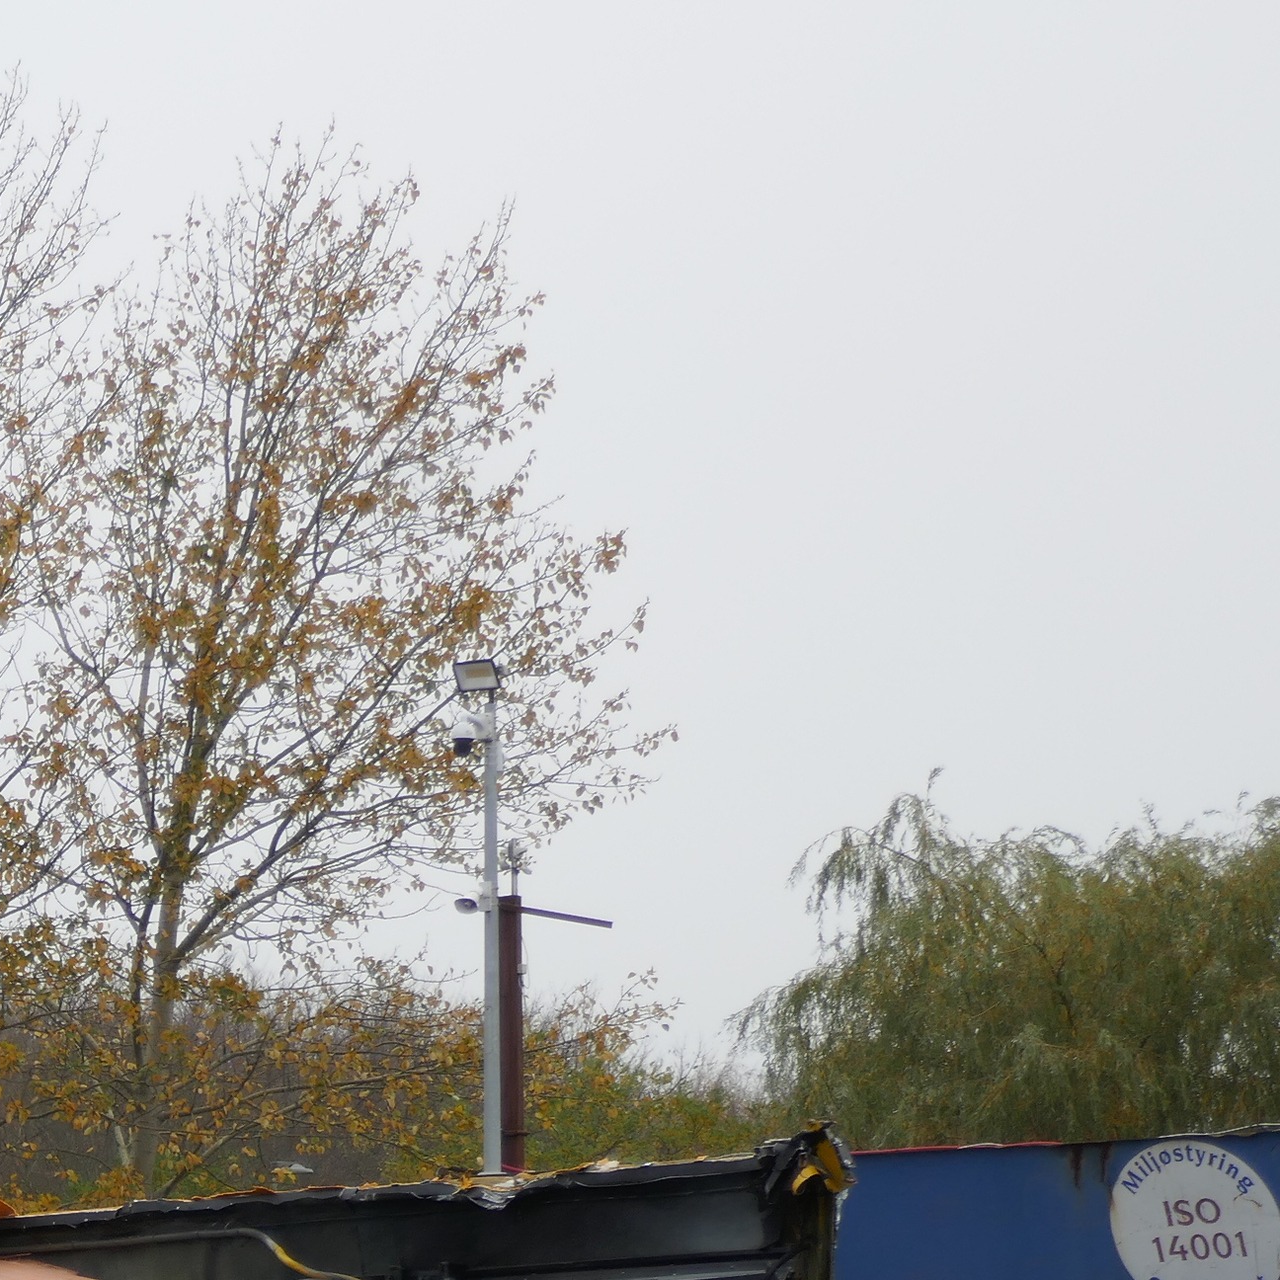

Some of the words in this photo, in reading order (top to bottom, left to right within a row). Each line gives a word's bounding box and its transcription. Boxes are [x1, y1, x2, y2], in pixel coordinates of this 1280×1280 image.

[1121, 1145, 1255, 1195] Miljøstyring
[1163, 1198, 1221, 1226] ISO
[1151, 1231, 1248, 1262] 14001
